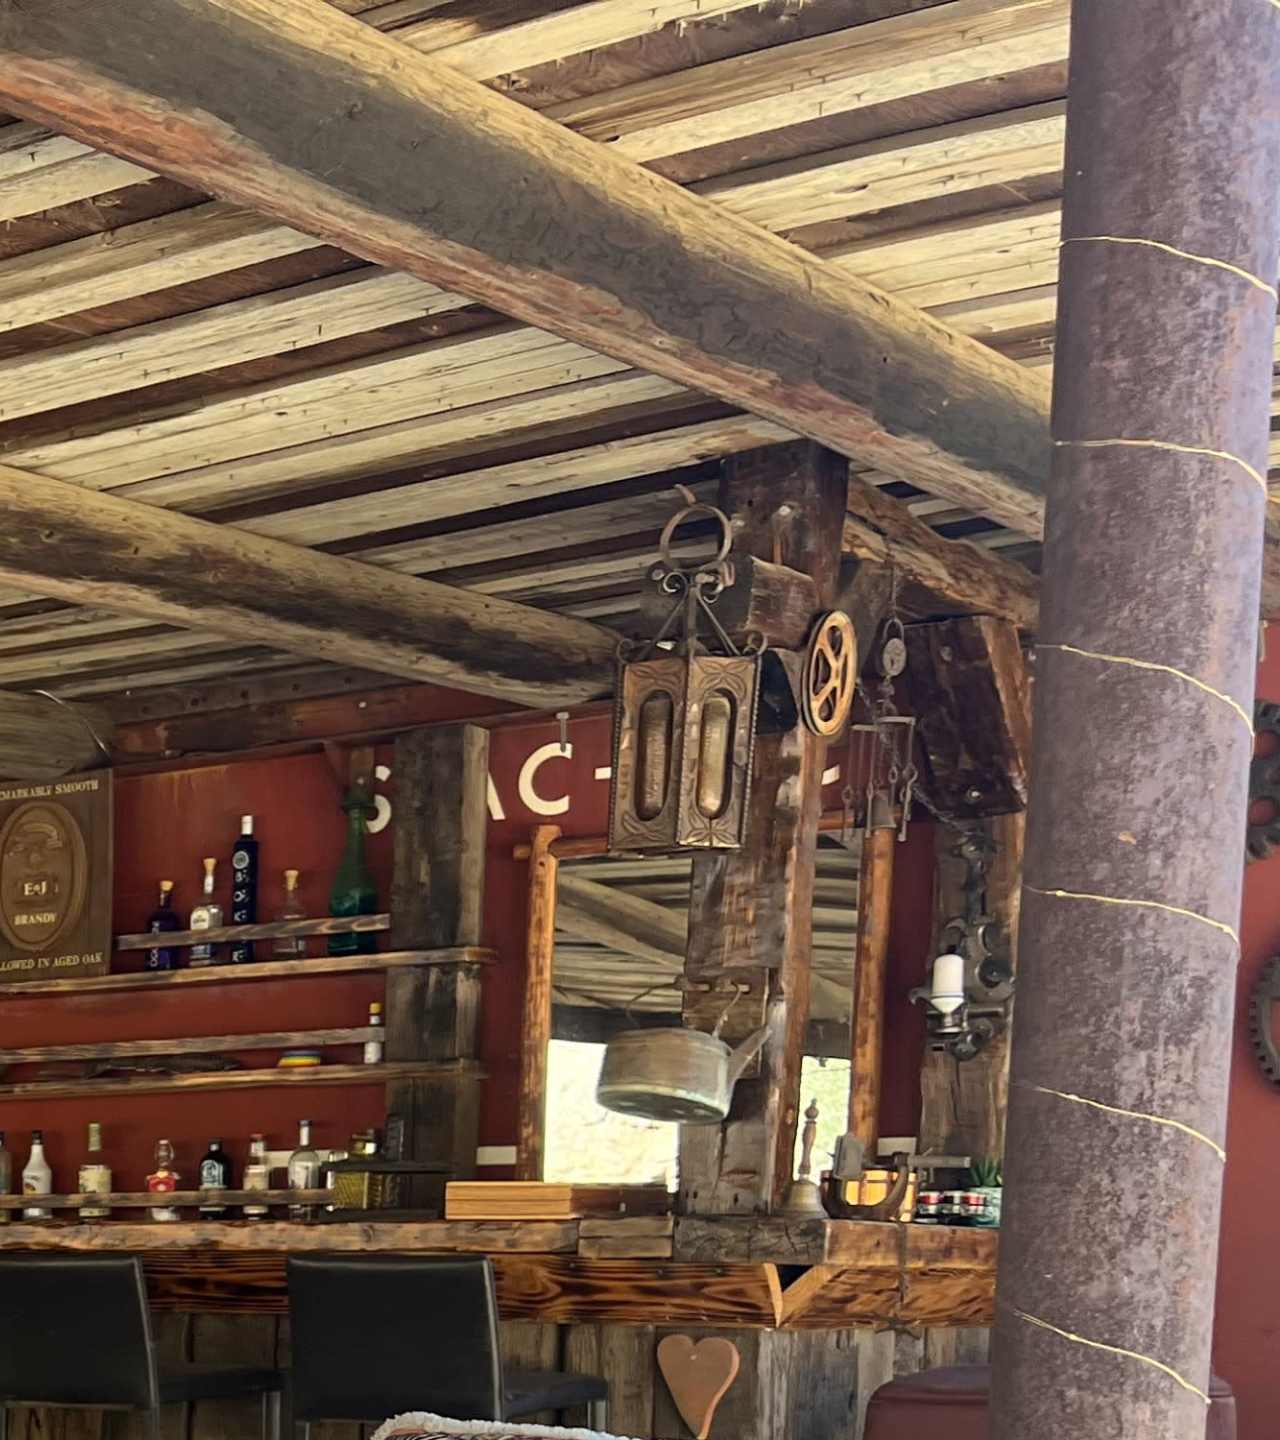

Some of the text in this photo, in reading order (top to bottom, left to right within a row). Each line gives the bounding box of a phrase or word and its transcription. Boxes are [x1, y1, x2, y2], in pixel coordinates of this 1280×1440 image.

[55, 779, 99, 795] SMOOTH
[14, 912, 57, 926] BRANDY
[37, 956, 49, 968] IN
[52, 954, 80, 968] AGED
[82, 952, 103, 964] OAK
